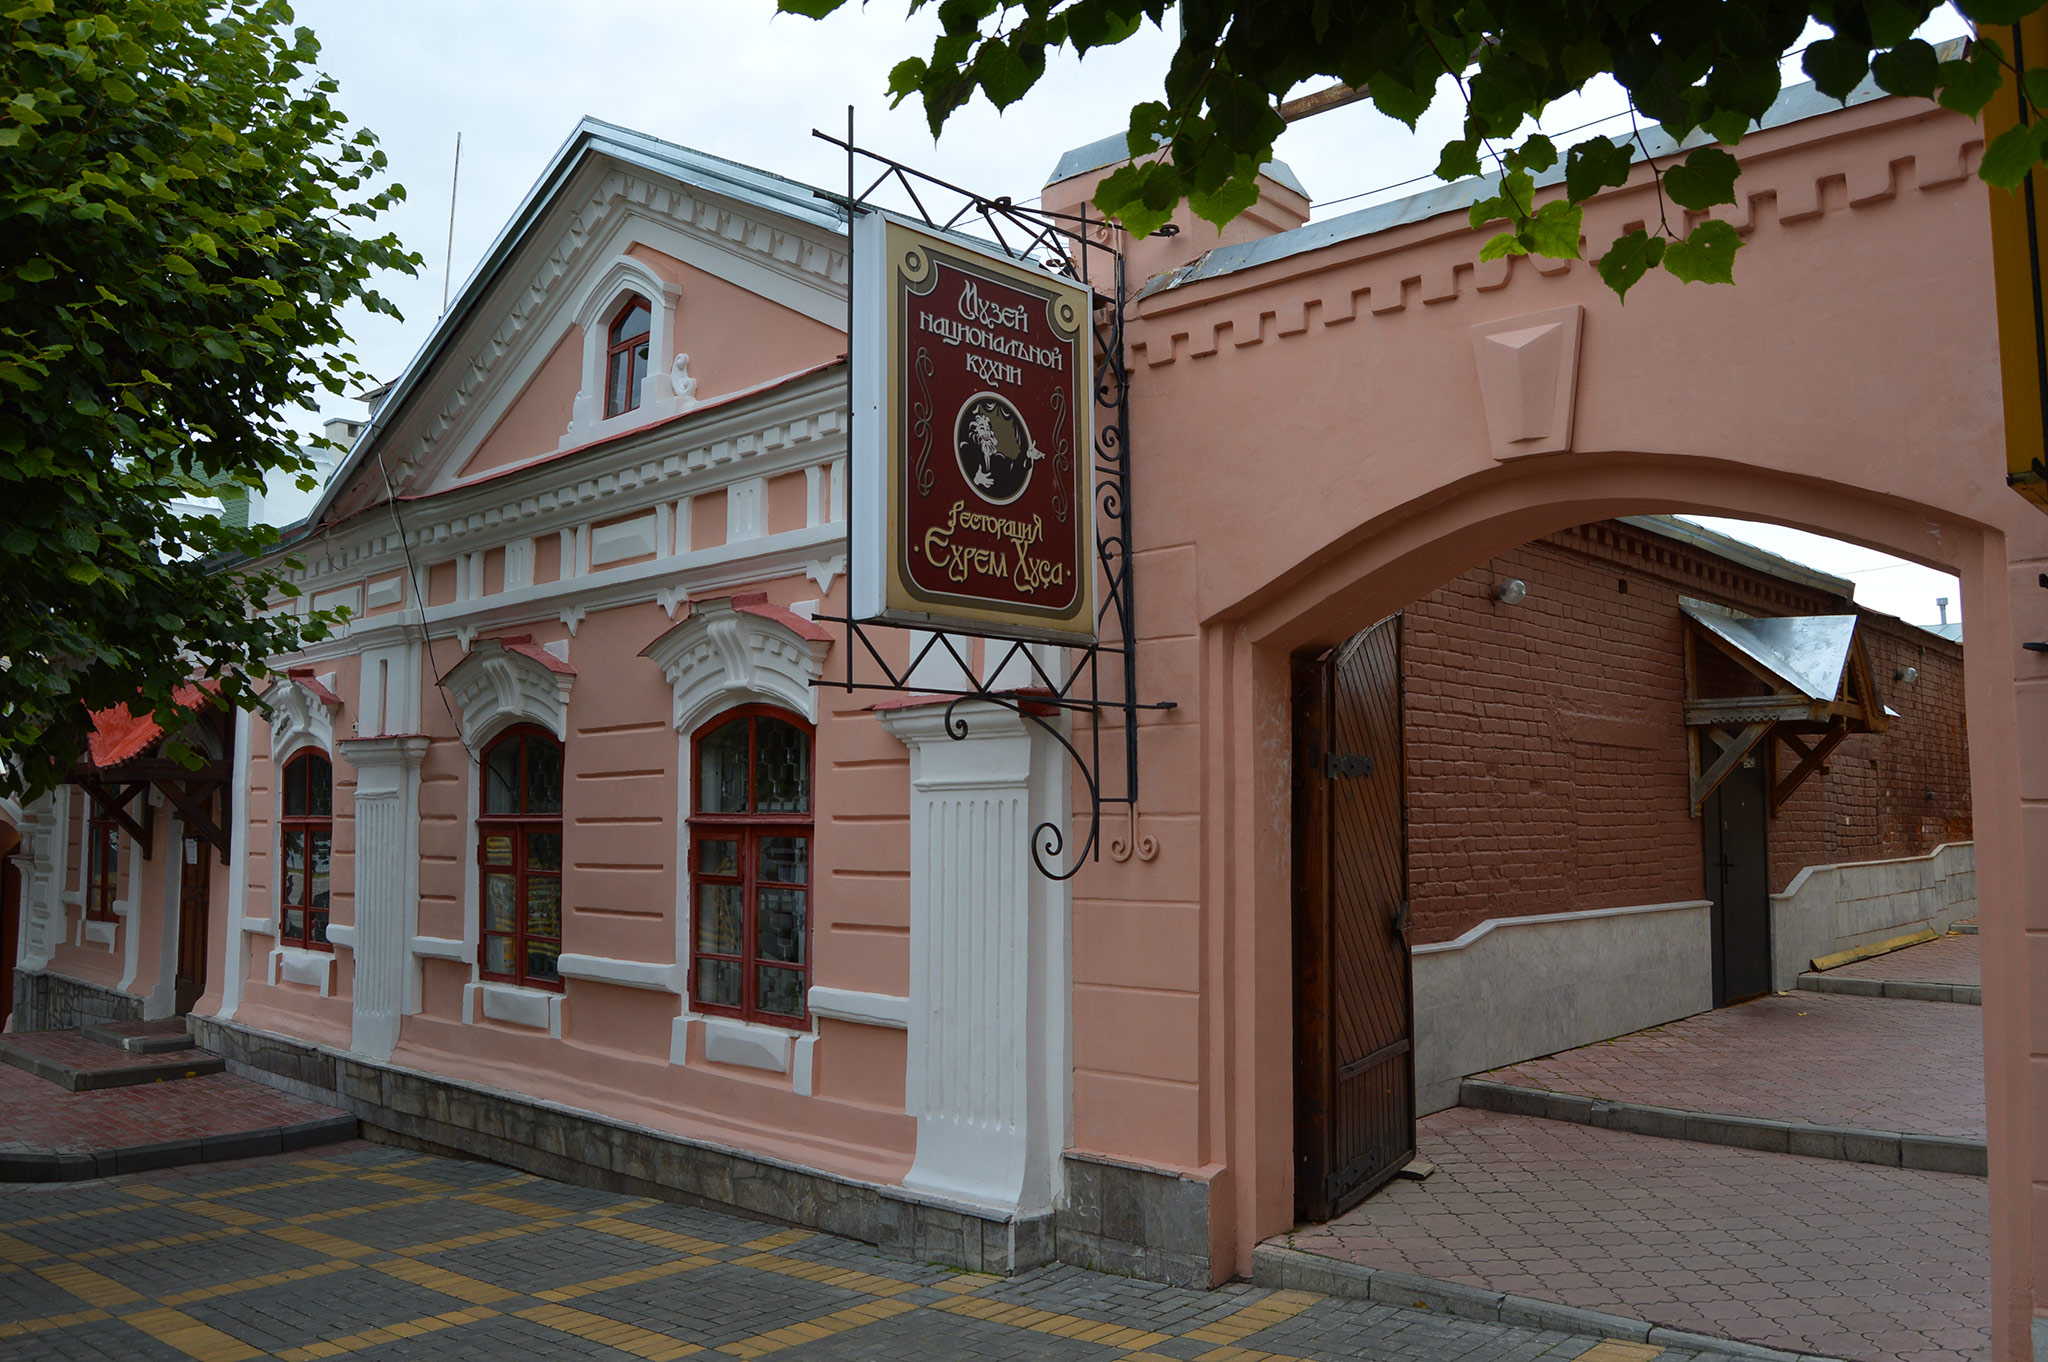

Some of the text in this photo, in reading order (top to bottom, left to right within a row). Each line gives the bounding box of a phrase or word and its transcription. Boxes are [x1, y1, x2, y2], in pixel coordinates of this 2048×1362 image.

[958, 279, 1029, 333] Музей
[948, 500, 1044, 544] Ресторация
[924, 526, 1009, 583] Ехрем
